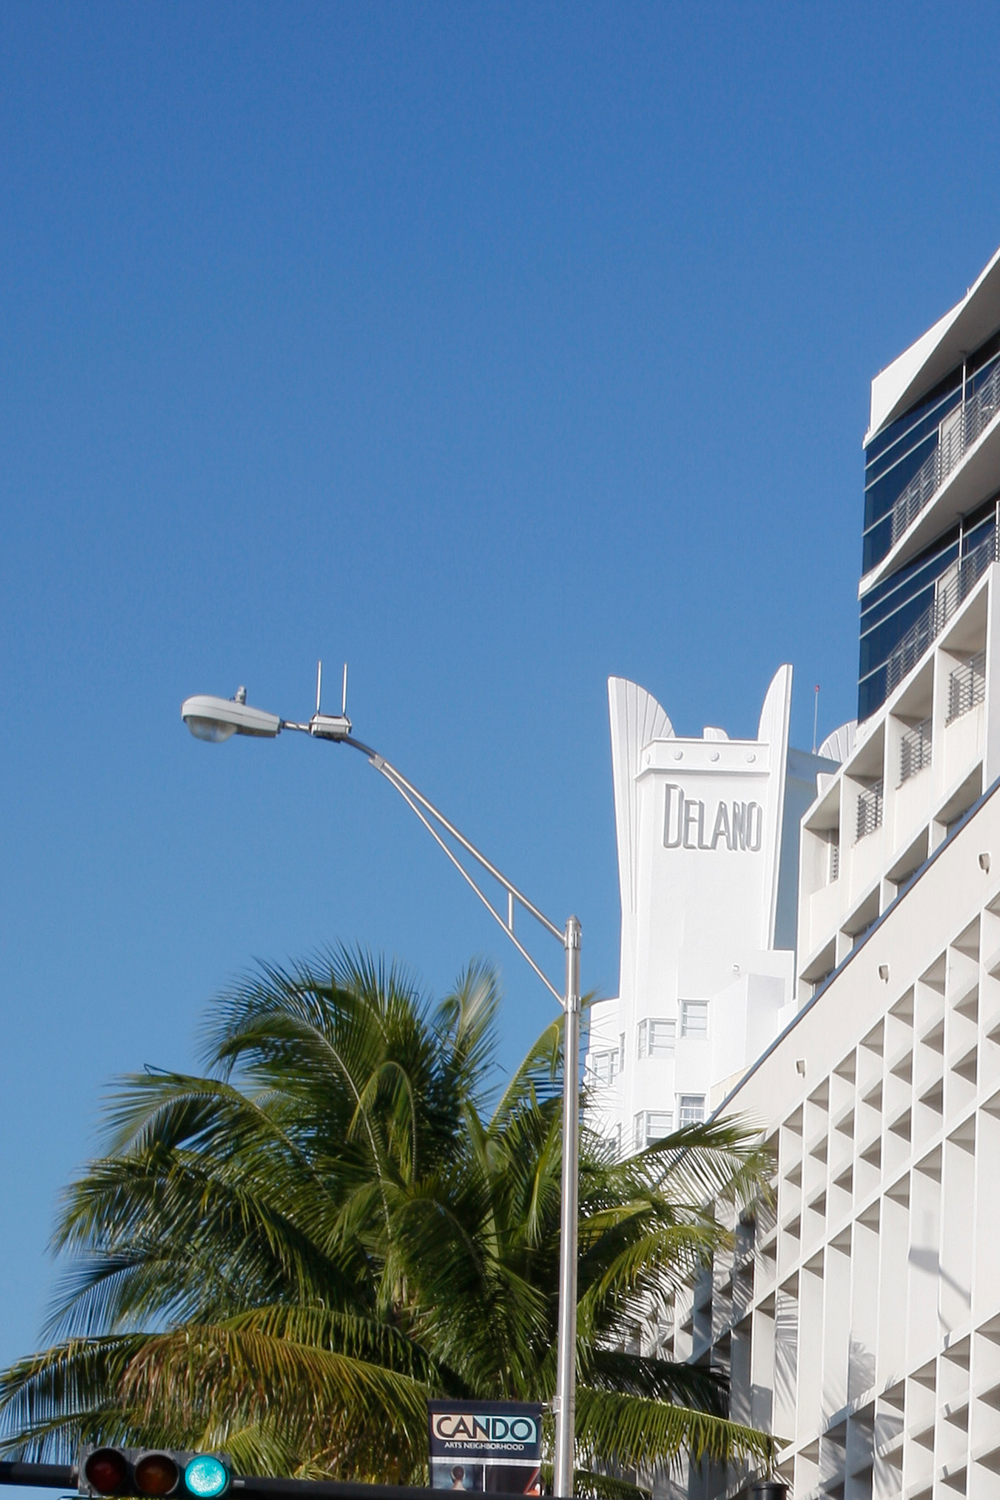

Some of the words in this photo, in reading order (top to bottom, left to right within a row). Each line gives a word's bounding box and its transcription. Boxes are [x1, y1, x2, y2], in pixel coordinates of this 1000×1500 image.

[663, 783, 763, 852] DELANO
[436, 1416, 533, 1441] CANDO
[464, 1442, 525, 1451] NEIGHBORHOOD
